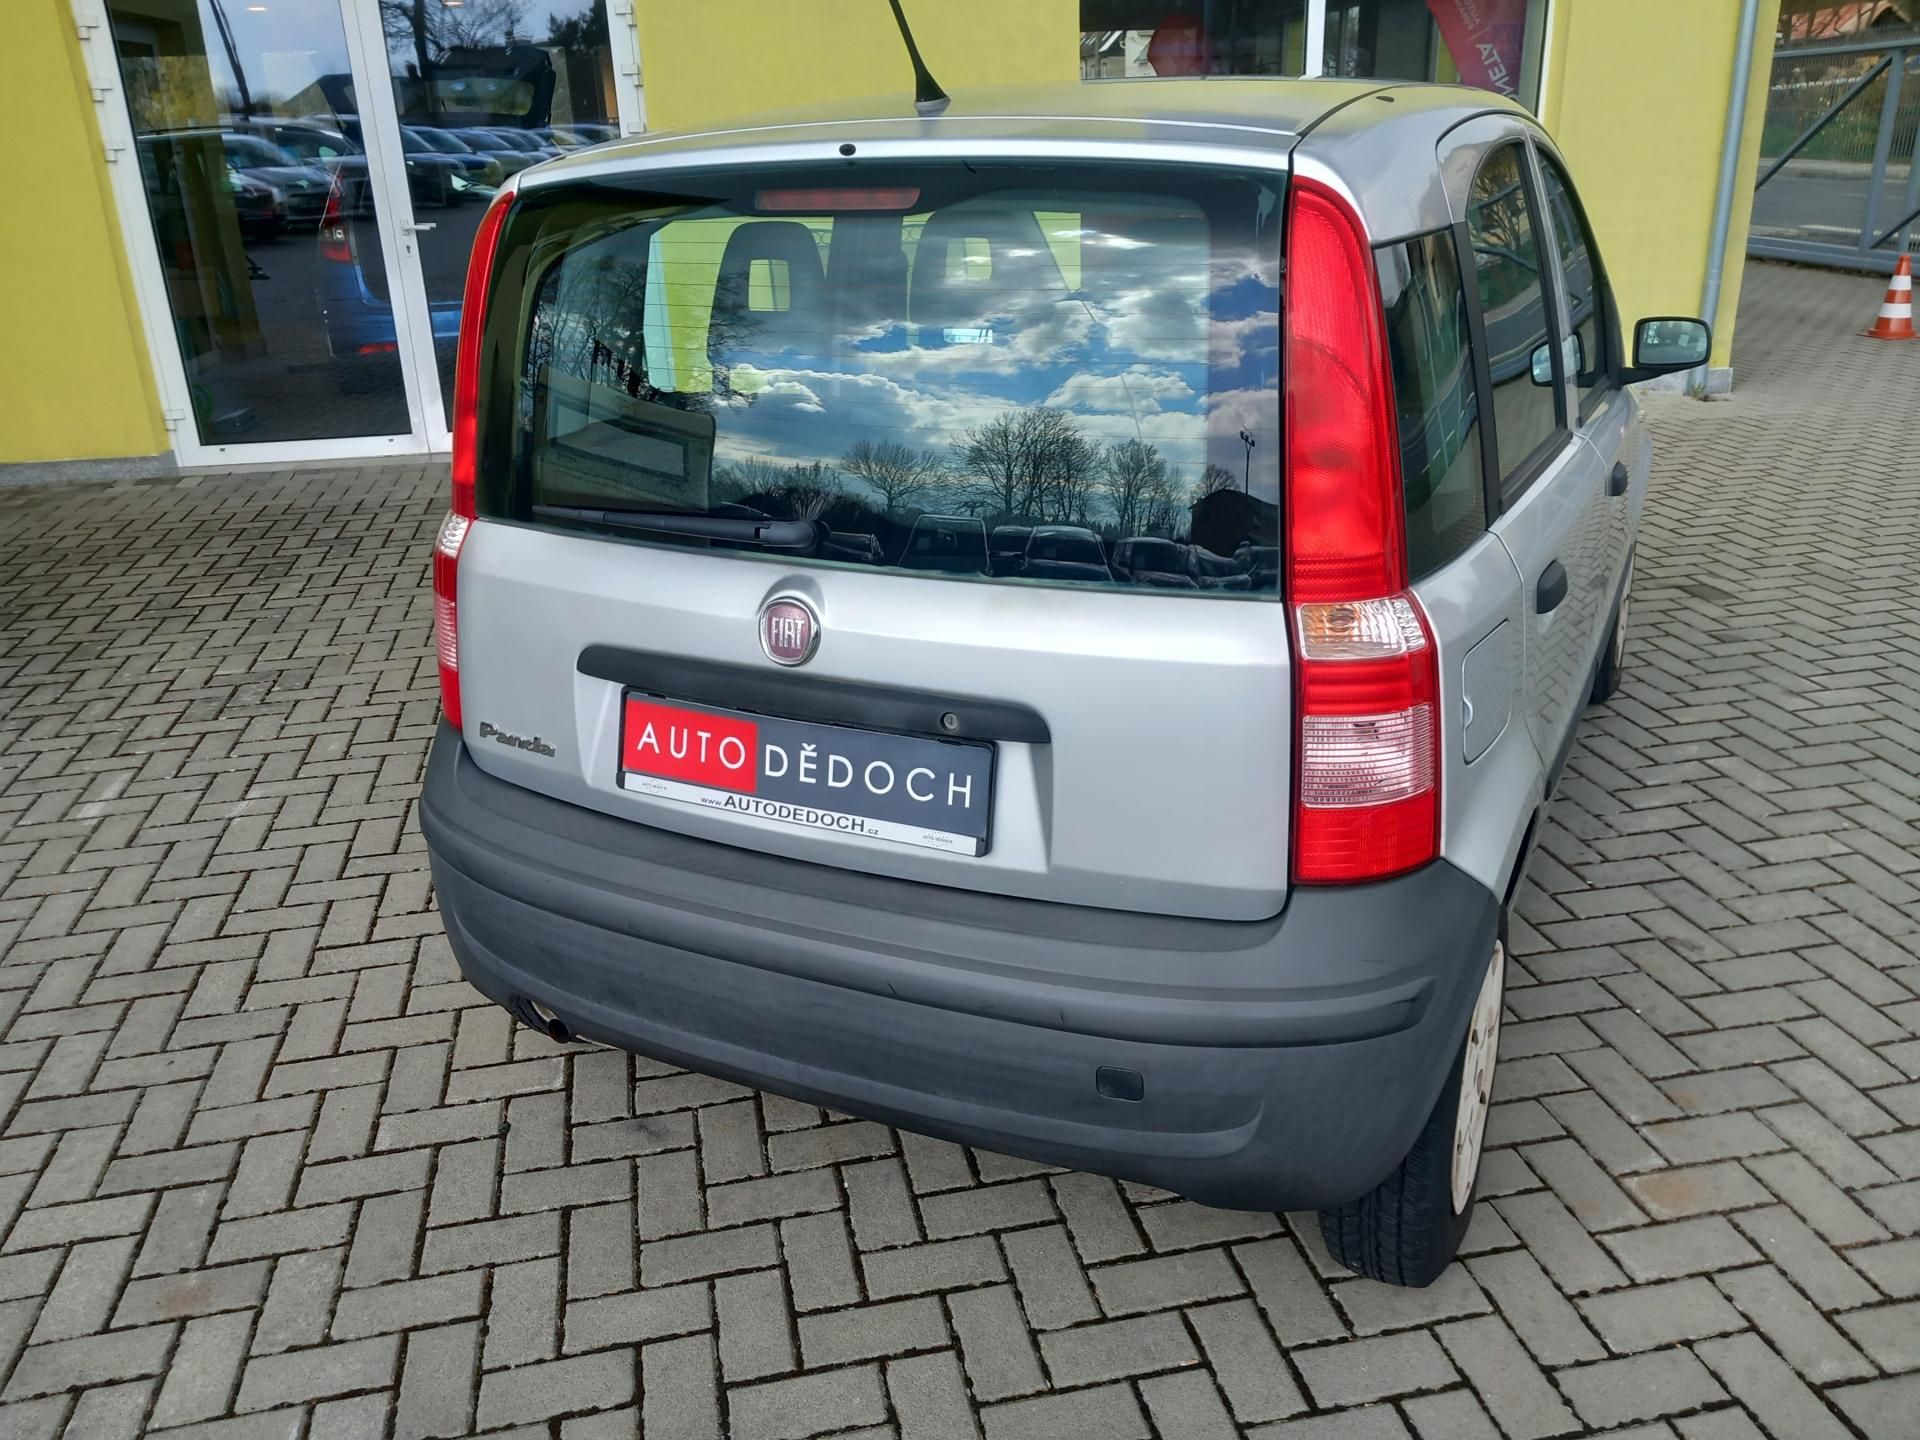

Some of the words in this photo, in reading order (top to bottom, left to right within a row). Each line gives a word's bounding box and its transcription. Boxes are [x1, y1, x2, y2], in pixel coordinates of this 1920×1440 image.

[770, 616, 806, 650] FIAT
[479, 720, 556, 758] Panda
[636, 721, 746, 770] AUTO
[764, 742, 972, 809] DĚDOCH
